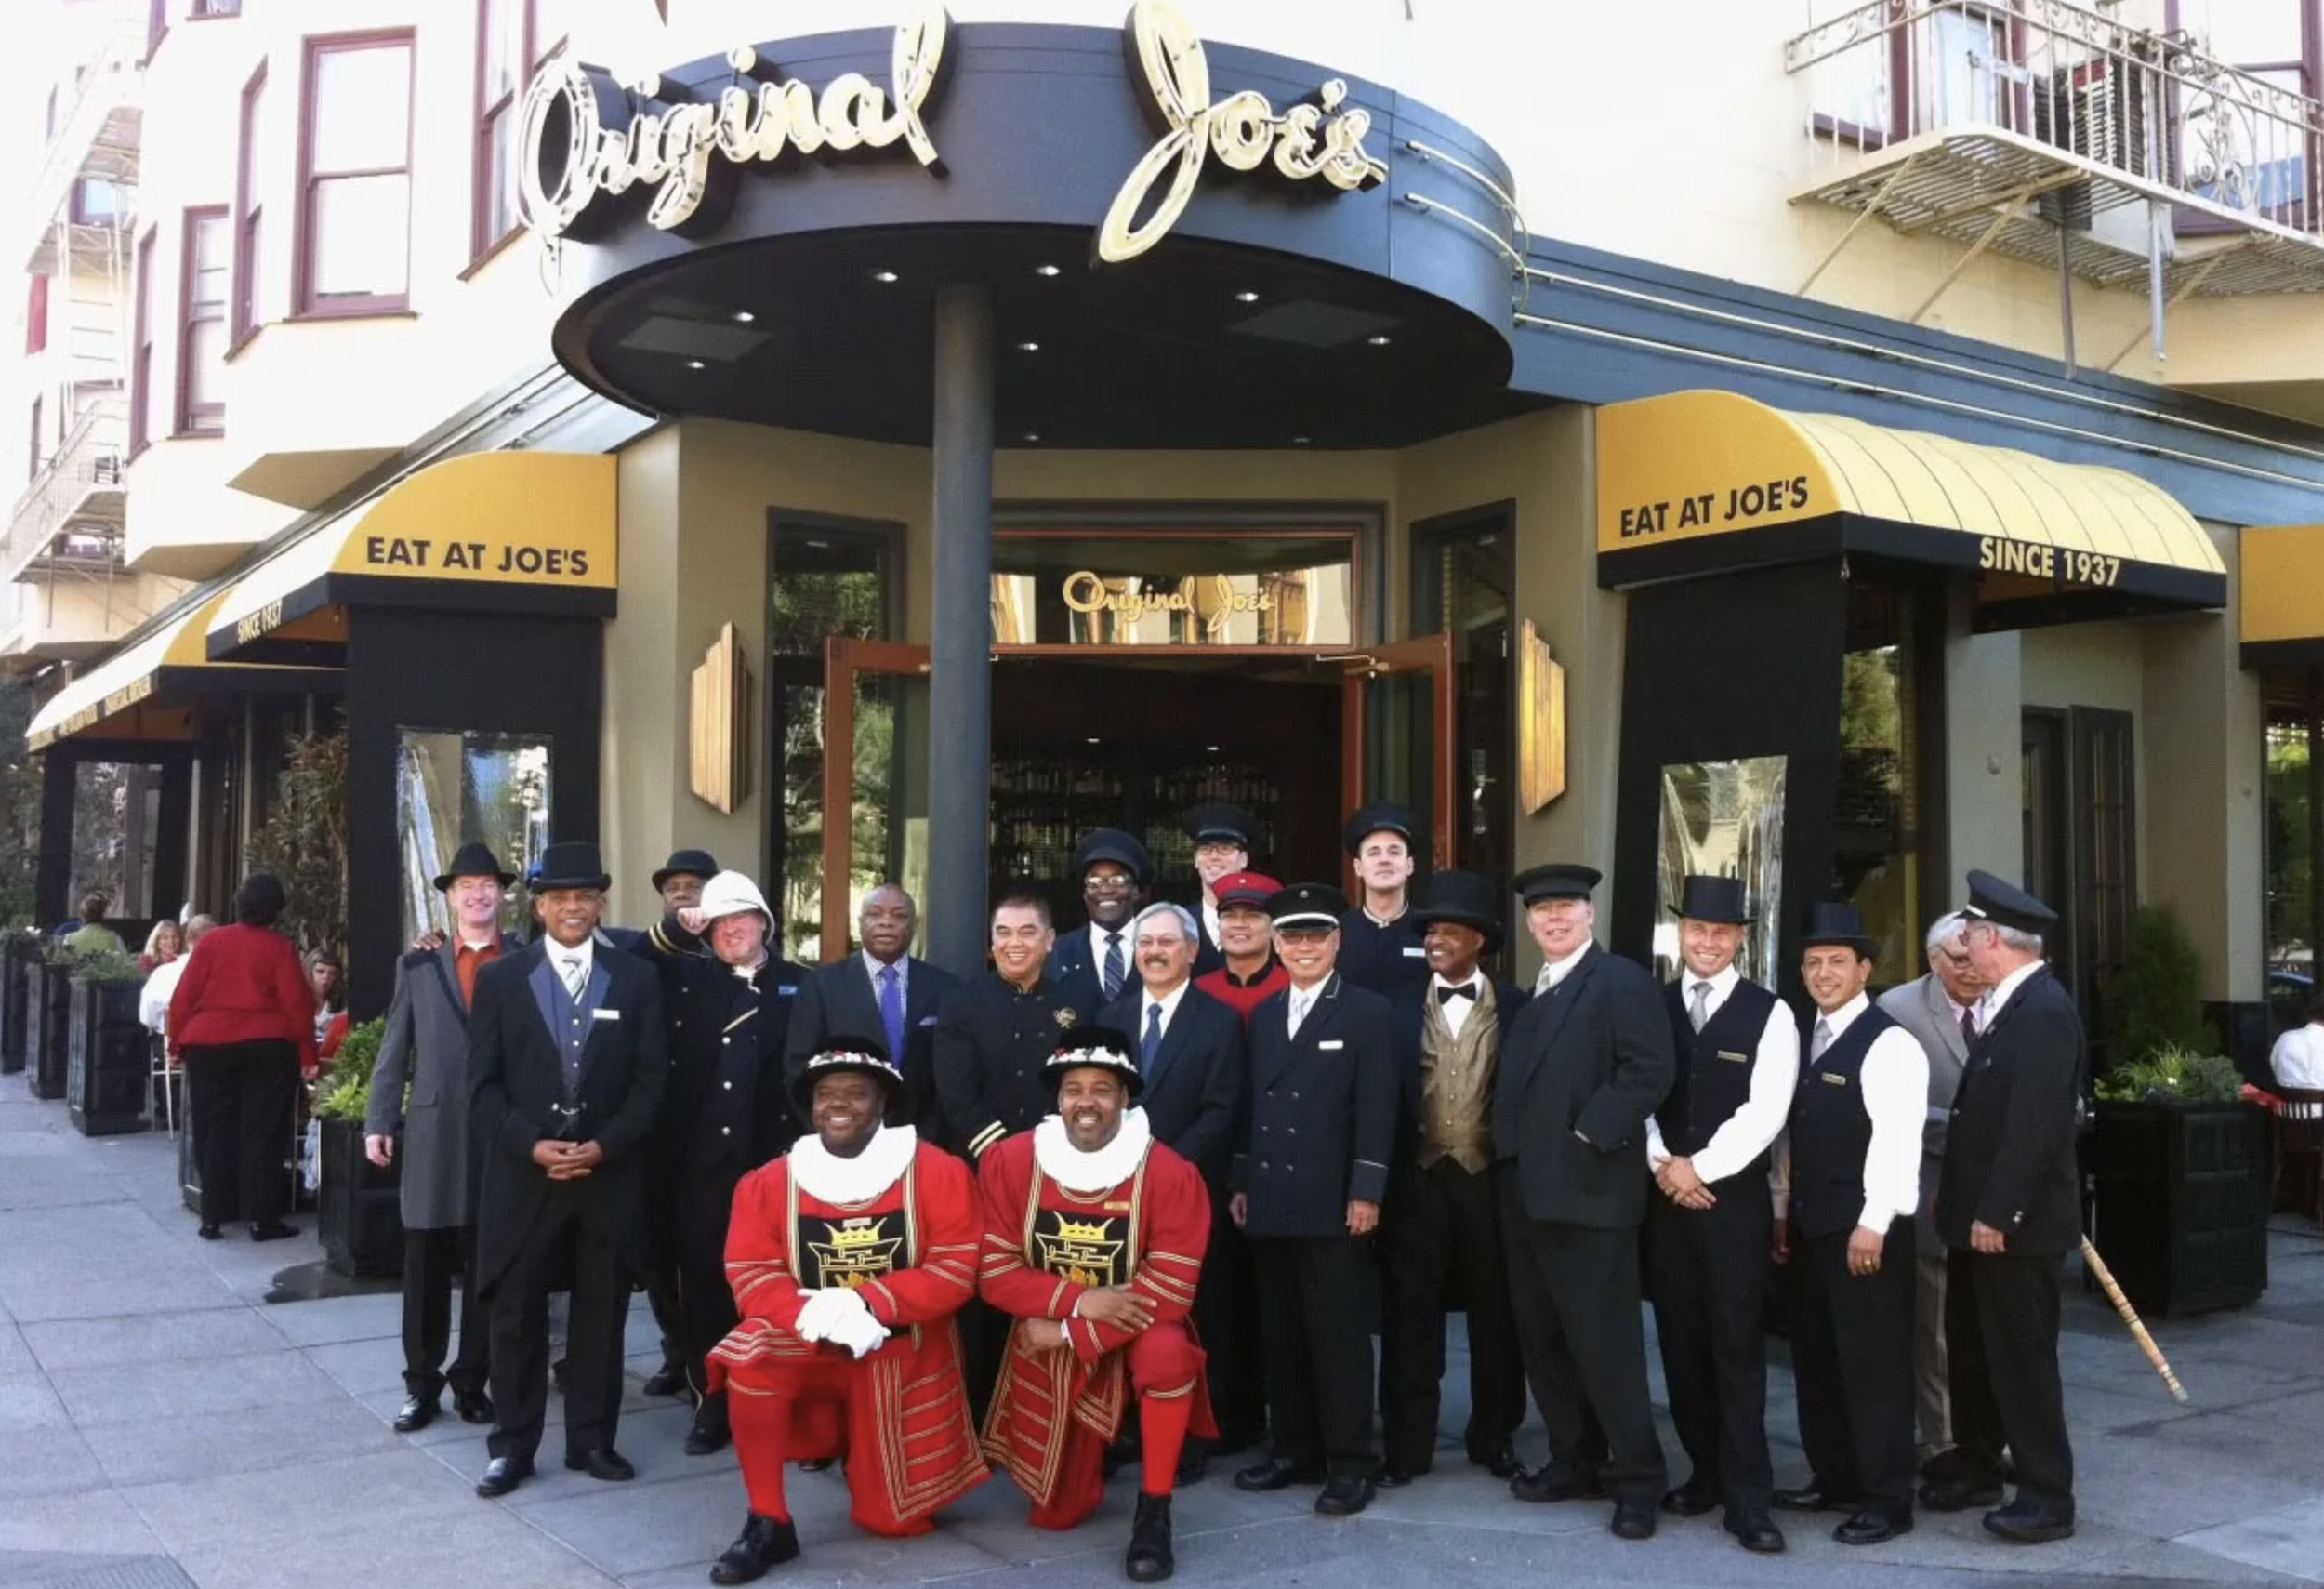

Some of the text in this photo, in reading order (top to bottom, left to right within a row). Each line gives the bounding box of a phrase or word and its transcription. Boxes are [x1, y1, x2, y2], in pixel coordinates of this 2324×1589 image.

[518, 0, 1389, 262] Original Joe's
[1620, 476, 1808, 537] EAT AT JOE'S
[367, 536, 588, 576] EAT AT JOE'S
[1979, 536, 2120, 588] SINCE 1937
[1063, 570, 1275, 633] Original Joe's
